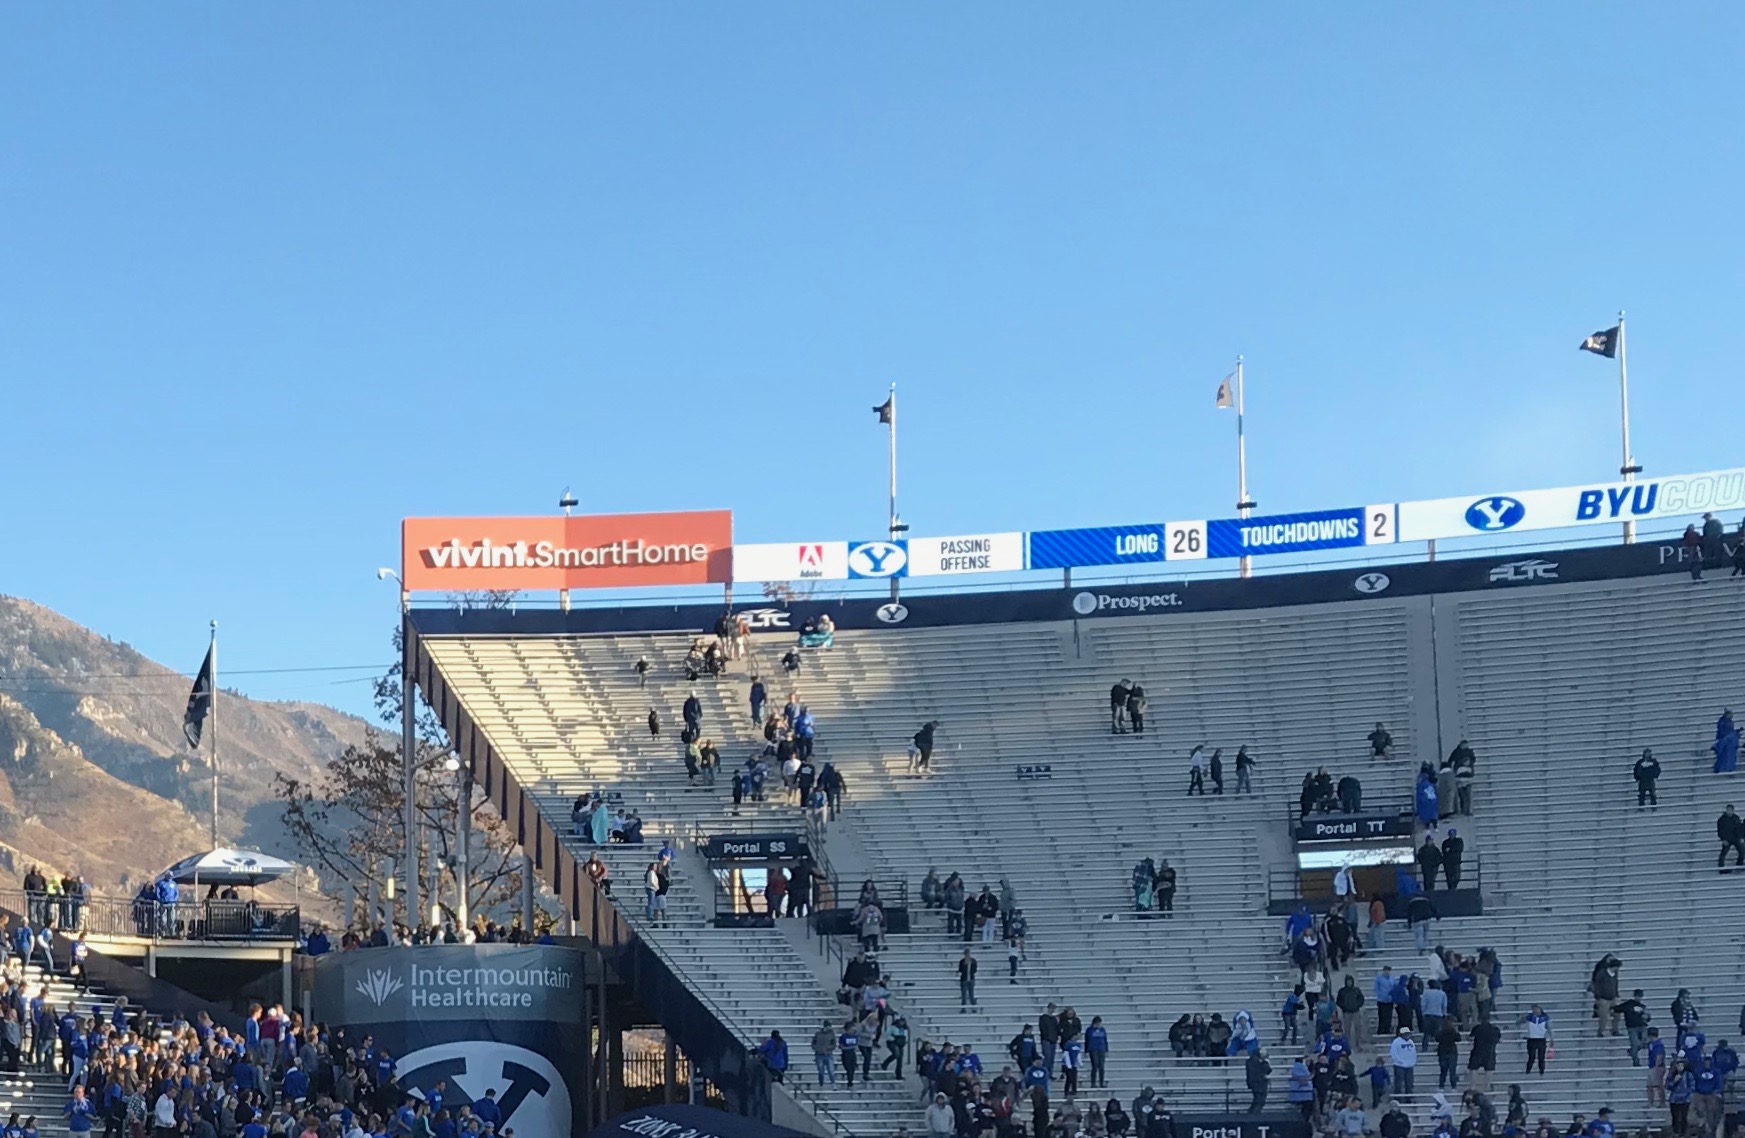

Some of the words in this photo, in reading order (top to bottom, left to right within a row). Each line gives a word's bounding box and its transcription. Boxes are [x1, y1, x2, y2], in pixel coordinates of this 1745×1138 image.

[1658, 472, 1745, 513] COU
[1240, 517, 1359, 548] TOUCHDOWNS
[1373, 512, 1387, 537] 2
[940, 538, 991, 555] PASSING
[1116, 533, 1159, 555] LONG
[1173, 528, 1201, 553] 26
[799, 569, 823, 578] Adobe
[940, 555, 991, 571] OFFENSE
[1316, 822, 1357, 835] Portal
[1366, 820, 1386, 832] TT
[723, 842, 760, 854] Portal
[769, 841, 786, 853] SS
[410, 963, 572, 989] Intermountain
[411, 987, 532, 1007] Healthcare
